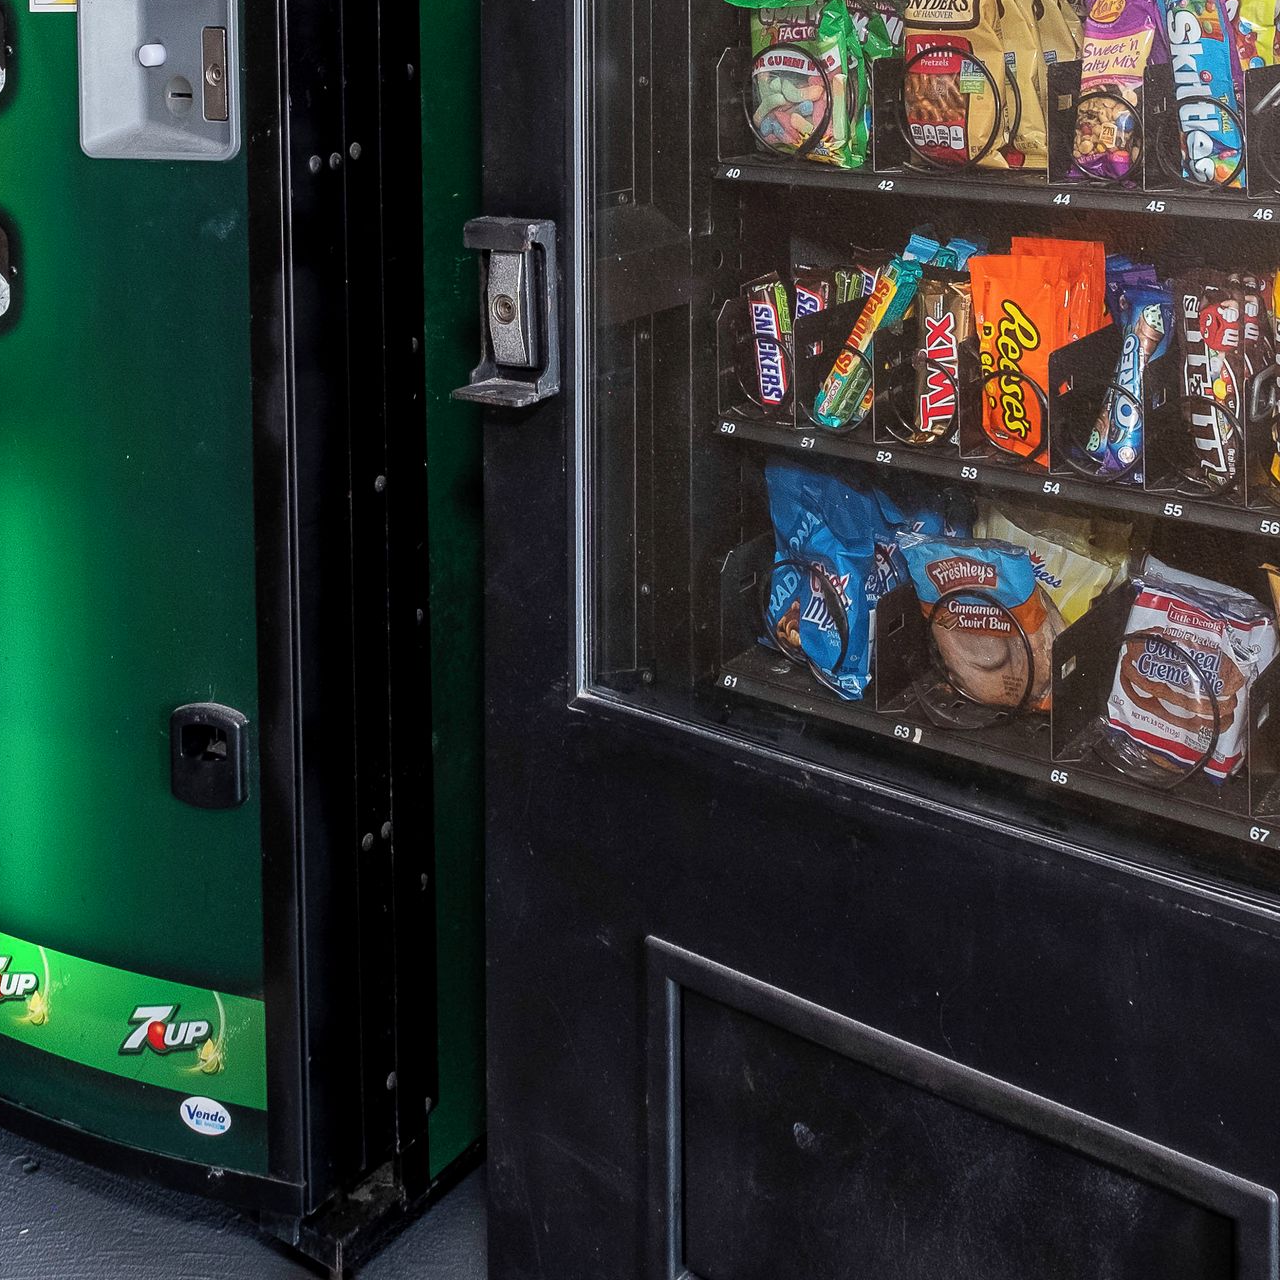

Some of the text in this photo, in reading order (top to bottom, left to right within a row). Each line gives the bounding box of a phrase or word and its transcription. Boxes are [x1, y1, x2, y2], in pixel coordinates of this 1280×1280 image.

[923, 10, 953, 19] HANOVER
[1083, 42, 1127, 59] Sweet
[920, 58, 949, 68] Pretzels
[1112, 55, 1139, 69] Mix
[1102, 125, 1116, 136] 270
[726, 168, 740, 179] 40
[878, 180, 894, 191] 42
[1053, 194, 1071, 205] 44
[1146, 201, 1166, 212] 45
[1253, 208, 1273, 220] 46
[752, 303, 785, 404] SNICKERS
[919, 311, 958, 433] TWIX
[999, 298, 1040, 439] Reese's
[720, 423, 736, 434] 50
[800, 438, 815, 448] 51
[876, 452, 892, 464] 52
[960, 467, 978, 480] 53
[1043, 482, 1061, 494] 54
[1163, 503, 1183, 517] 55
[1260, 520, 1280, 535] 56
[932, 562, 995, 585] Freshley's
[1169, 609, 1192, 624] Little
[958, 615, 1011, 632] Swirl Bun
[1138, 654, 1189, 685] Creme
[724, 676, 738, 687] 61
[894, 725, 910, 738] 63
[1051, 769, 1068, 784] 65
[1249, 827, 1270, 842] 67
[120, 1004, 212, 1054] 7UP
[184, 1103, 226, 1123] Vendo
